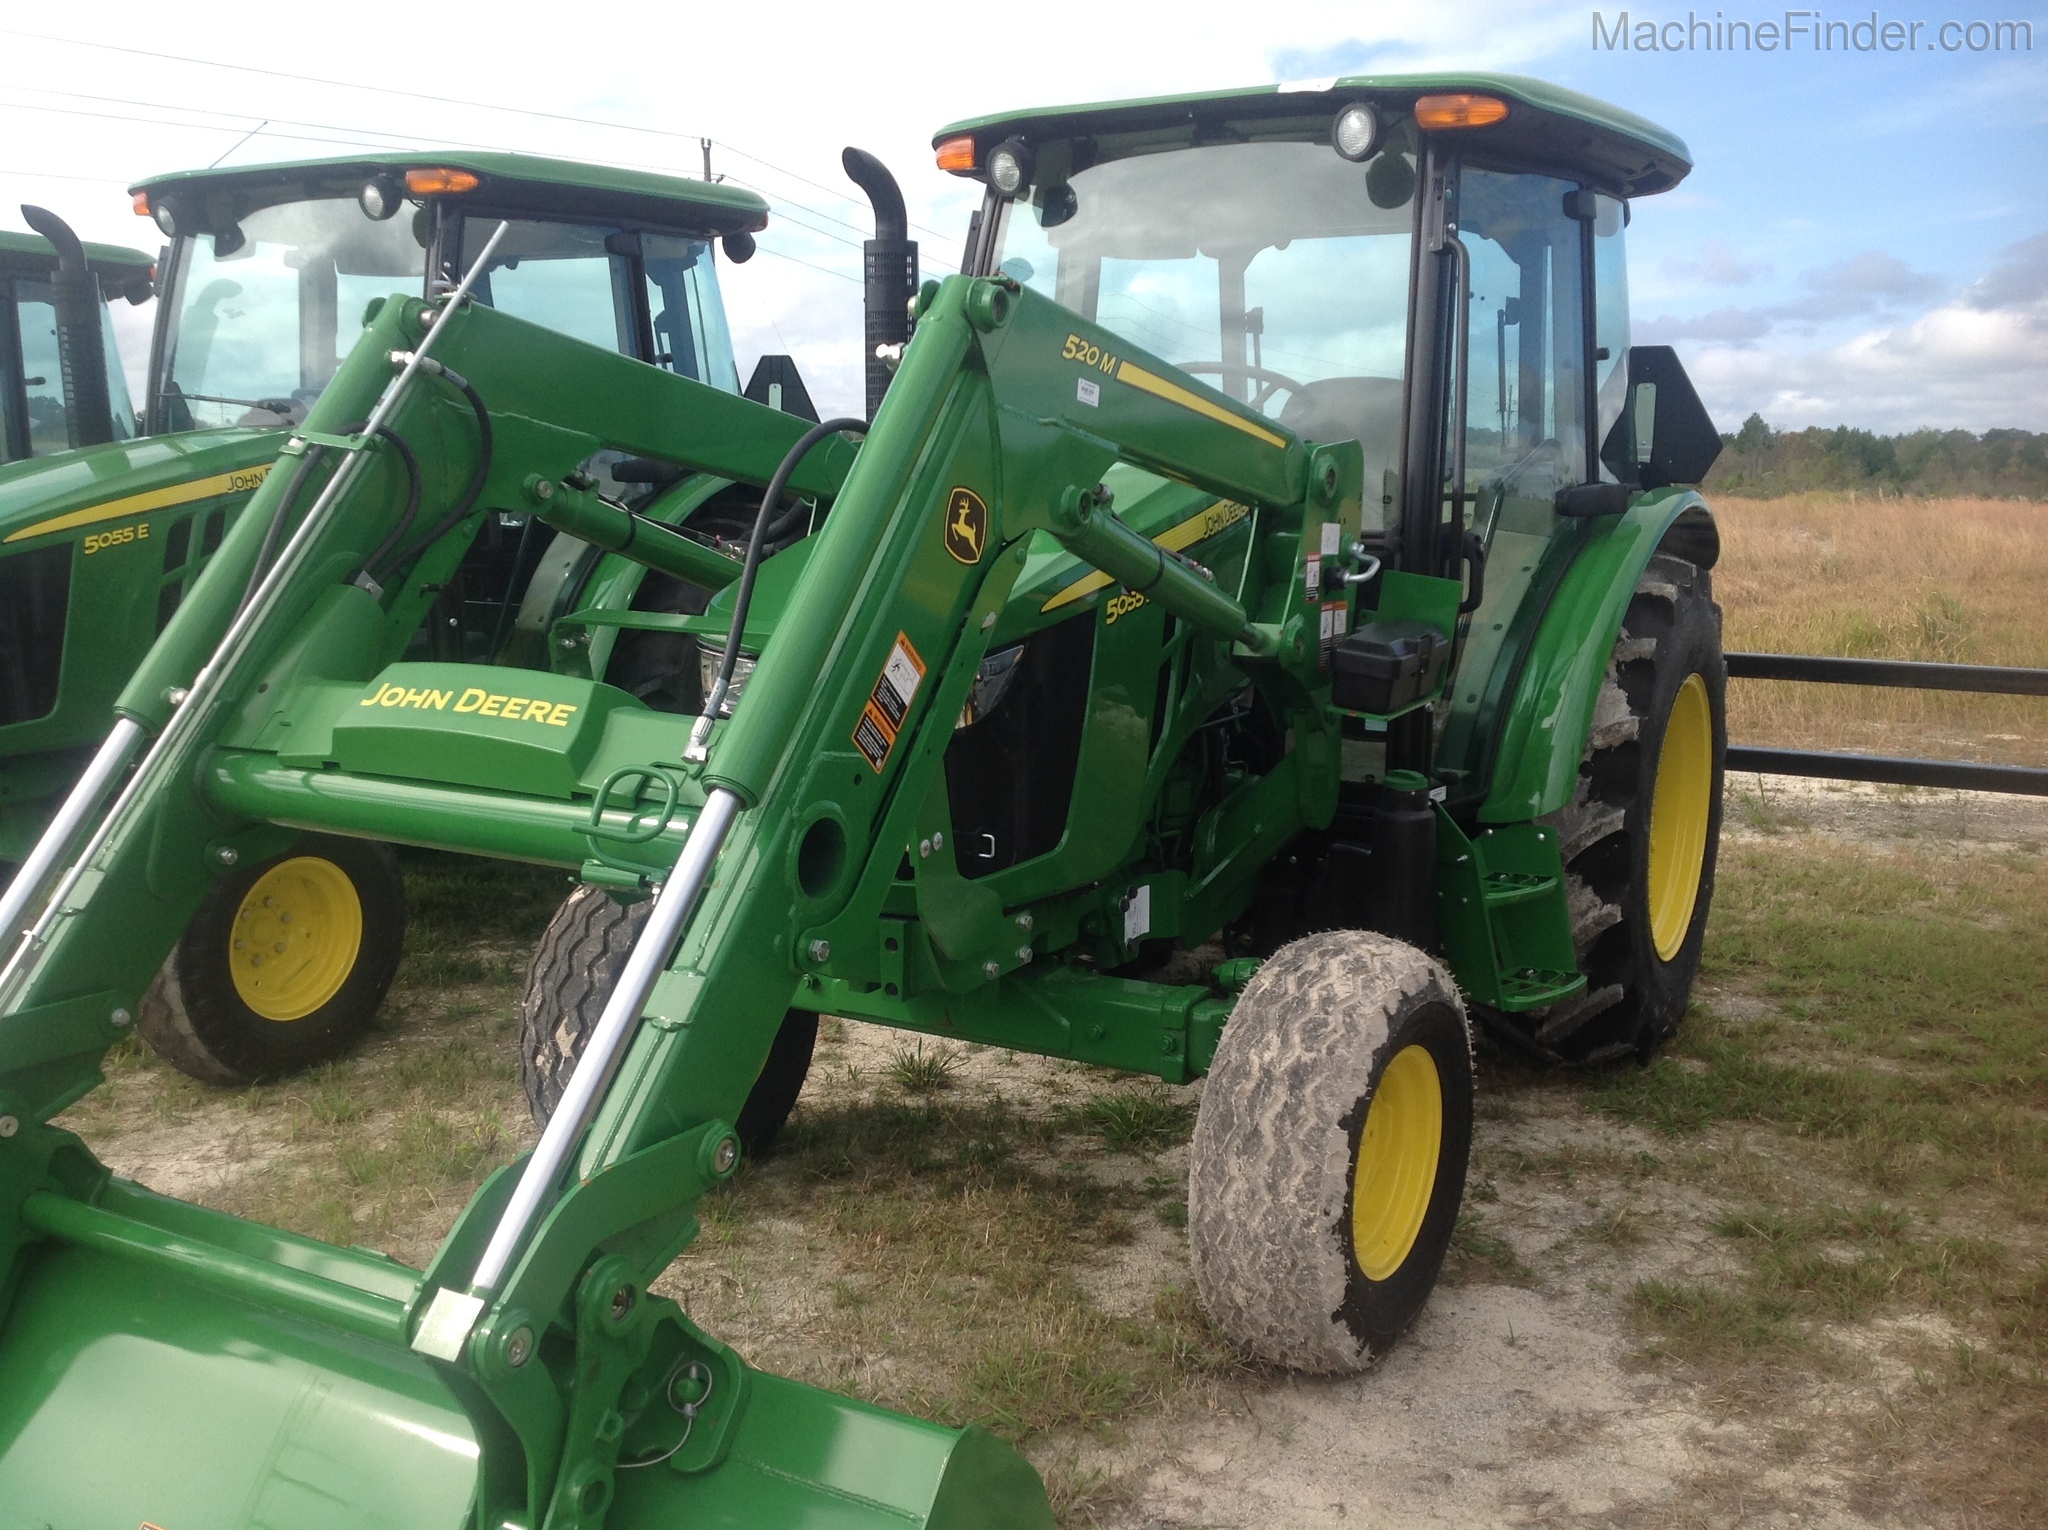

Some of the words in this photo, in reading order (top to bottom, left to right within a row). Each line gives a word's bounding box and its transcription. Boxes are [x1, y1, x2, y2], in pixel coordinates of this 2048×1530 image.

[1061, 332, 1100, 366] 520
[1099, 352, 1117, 375] M
[227, 472, 264, 492] JOHN
[84, 526, 135, 555] 5055
[137, 522, 150, 540] E
[1203, 512, 1223, 537] JOHN
[360, 682, 454, 711] JOHN
[452, 687, 578, 727] DEERE
